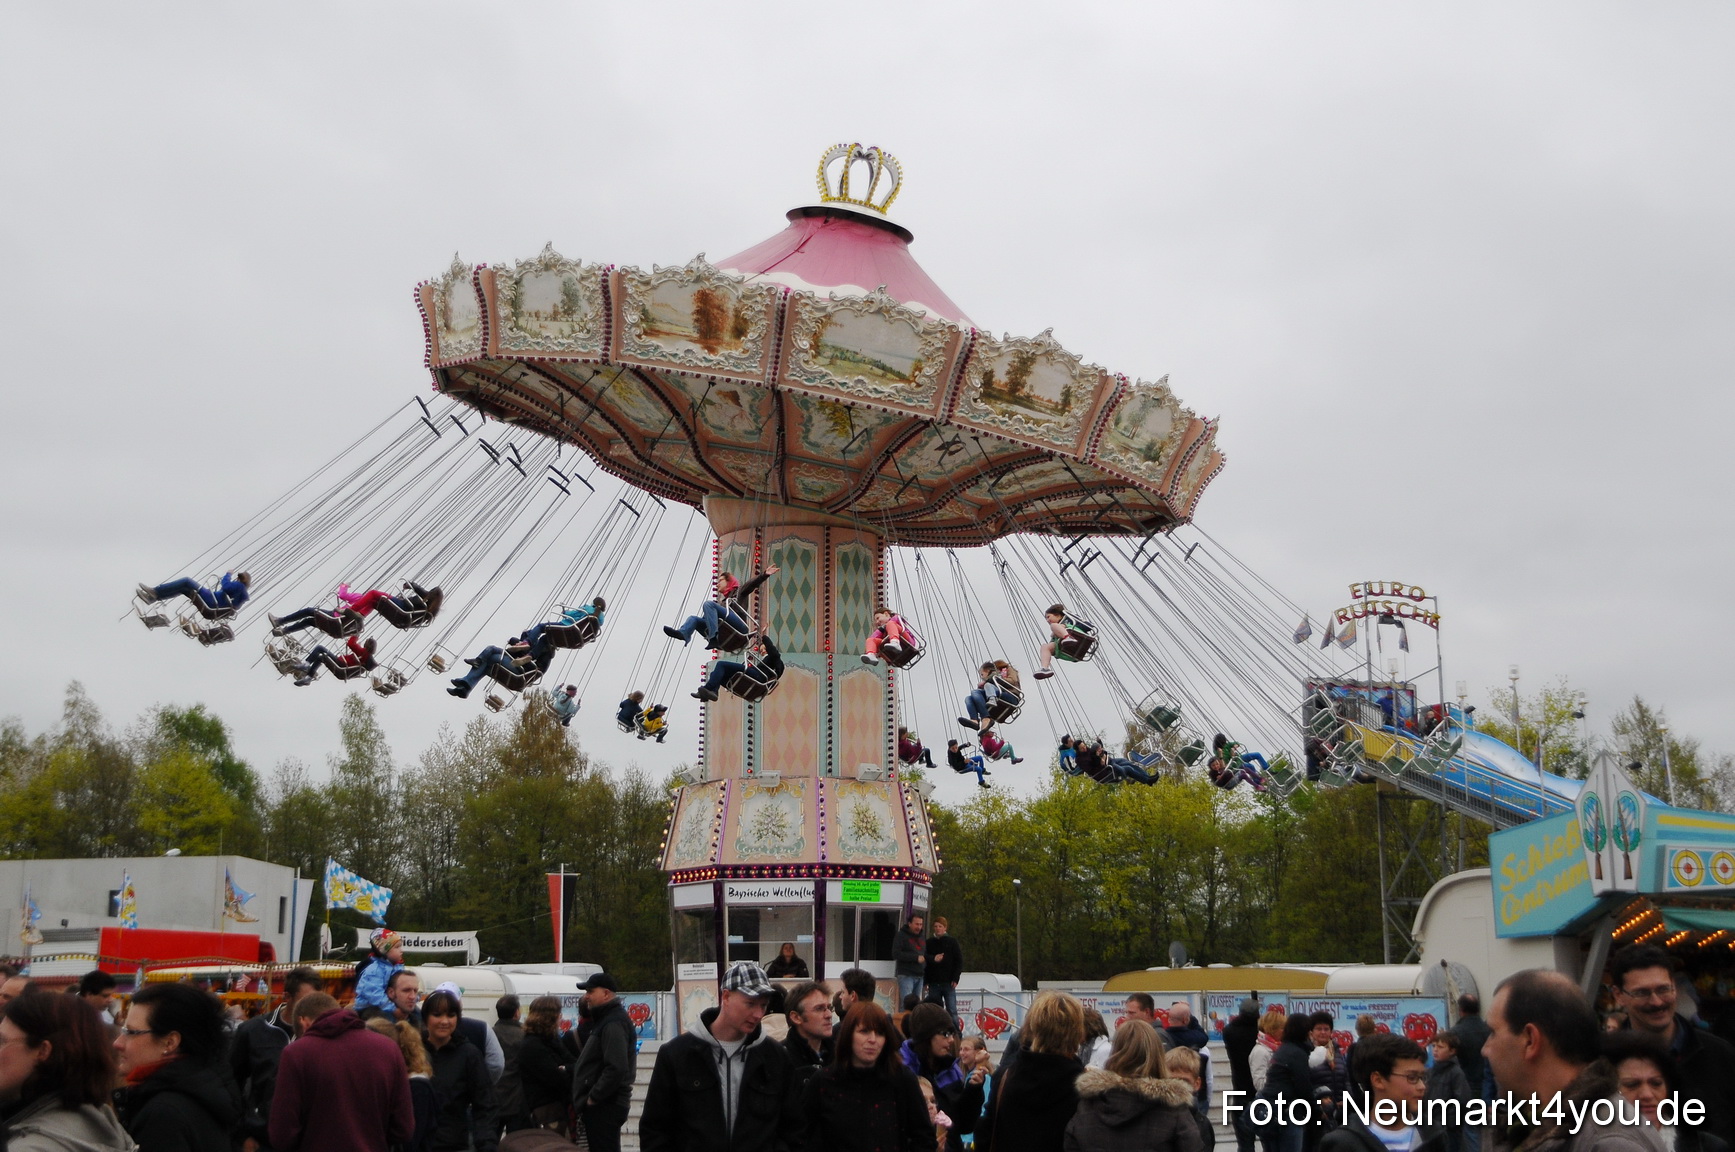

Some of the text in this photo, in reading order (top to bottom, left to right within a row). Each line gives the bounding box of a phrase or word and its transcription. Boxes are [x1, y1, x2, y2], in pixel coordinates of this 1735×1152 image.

[1348, 580, 1425, 602] EURO
[1334, 600, 1439, 631] RUTSCHE
[1500, 819, 1581, 892] Schieß
[728, 887, 770, 899] Bayrischer
[400, 936, 463, 948] iedersehen
[1291, 1001, 1341, 1019] VOLKSFEST
